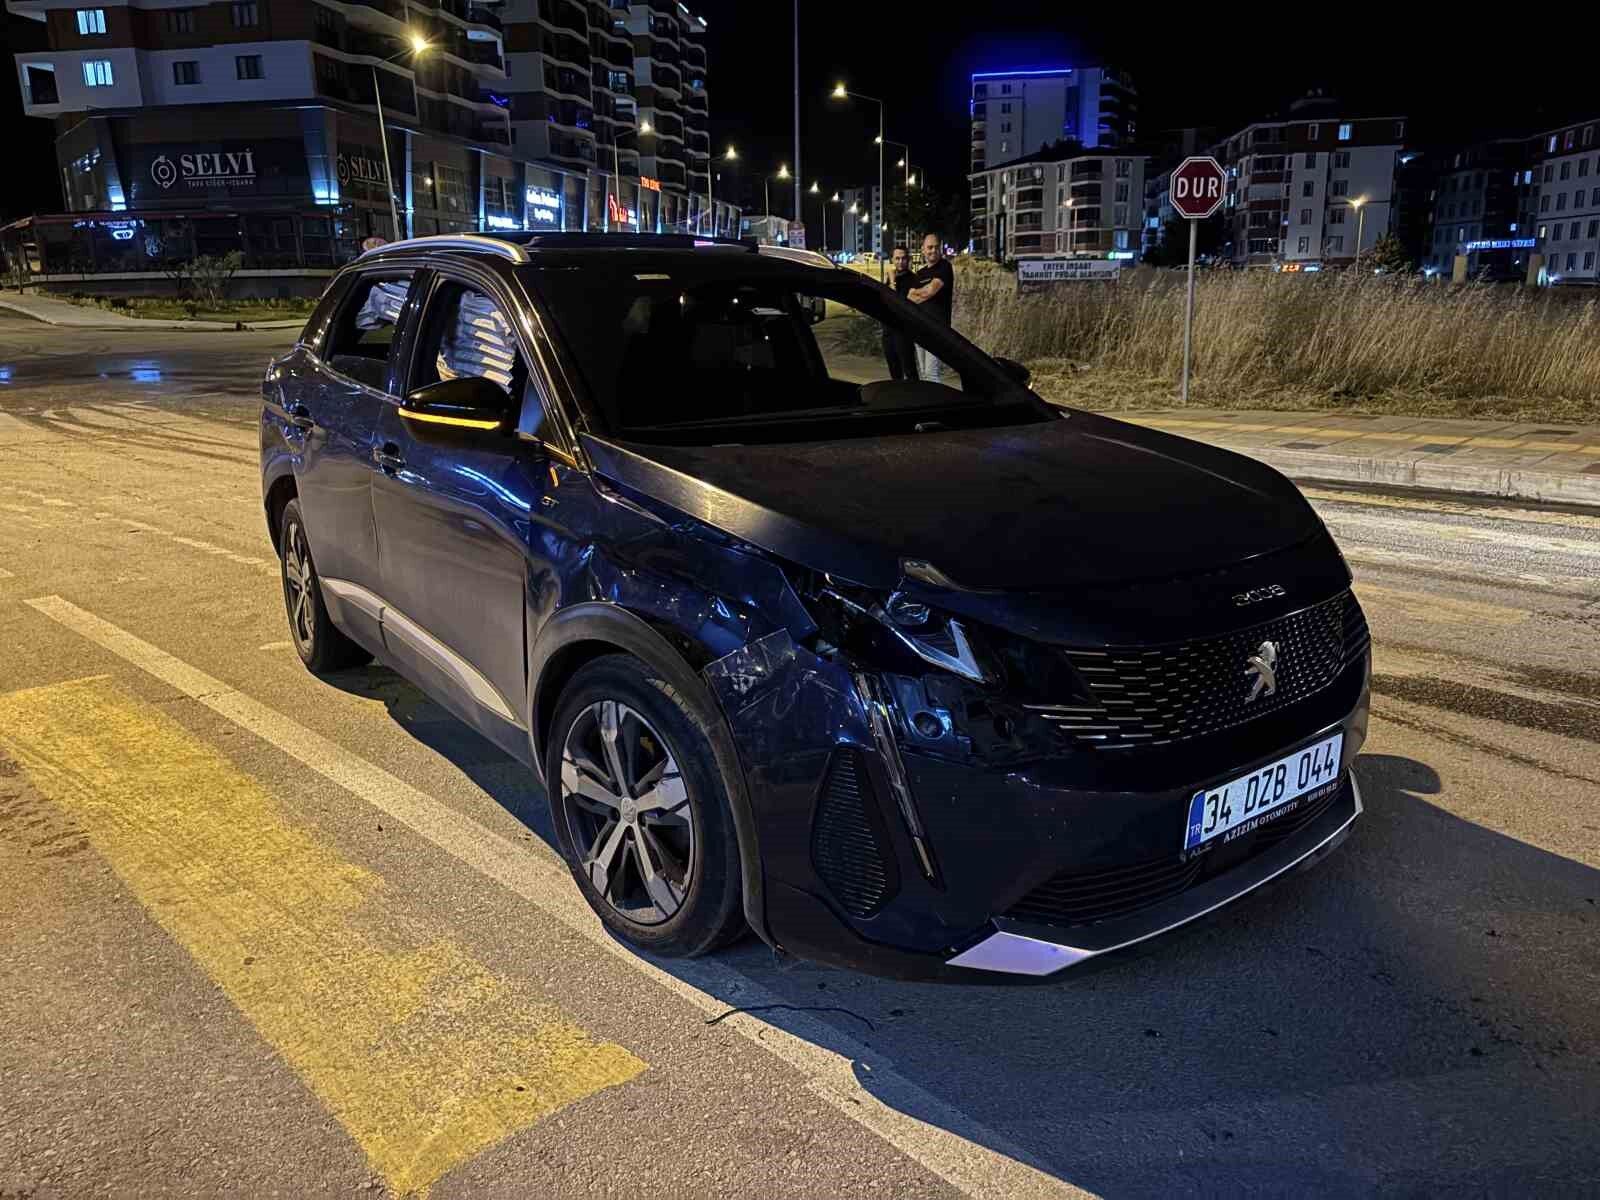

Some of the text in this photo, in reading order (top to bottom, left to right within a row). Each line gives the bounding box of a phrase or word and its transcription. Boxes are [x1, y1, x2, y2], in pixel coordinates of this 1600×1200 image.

[180, 147, 257, 176] SELVİ
[1176, 176, 1219, 199] DUR
[541, 495, 560, 509] GT
[1231, 584, 1287, 607] 3008
[1203, 787, 1232, 834] 34
[1243, 763, 1288, 815] DZB
[1297, 742, 1335, 790] 044
[1190, 822, 1202, 837] TR
